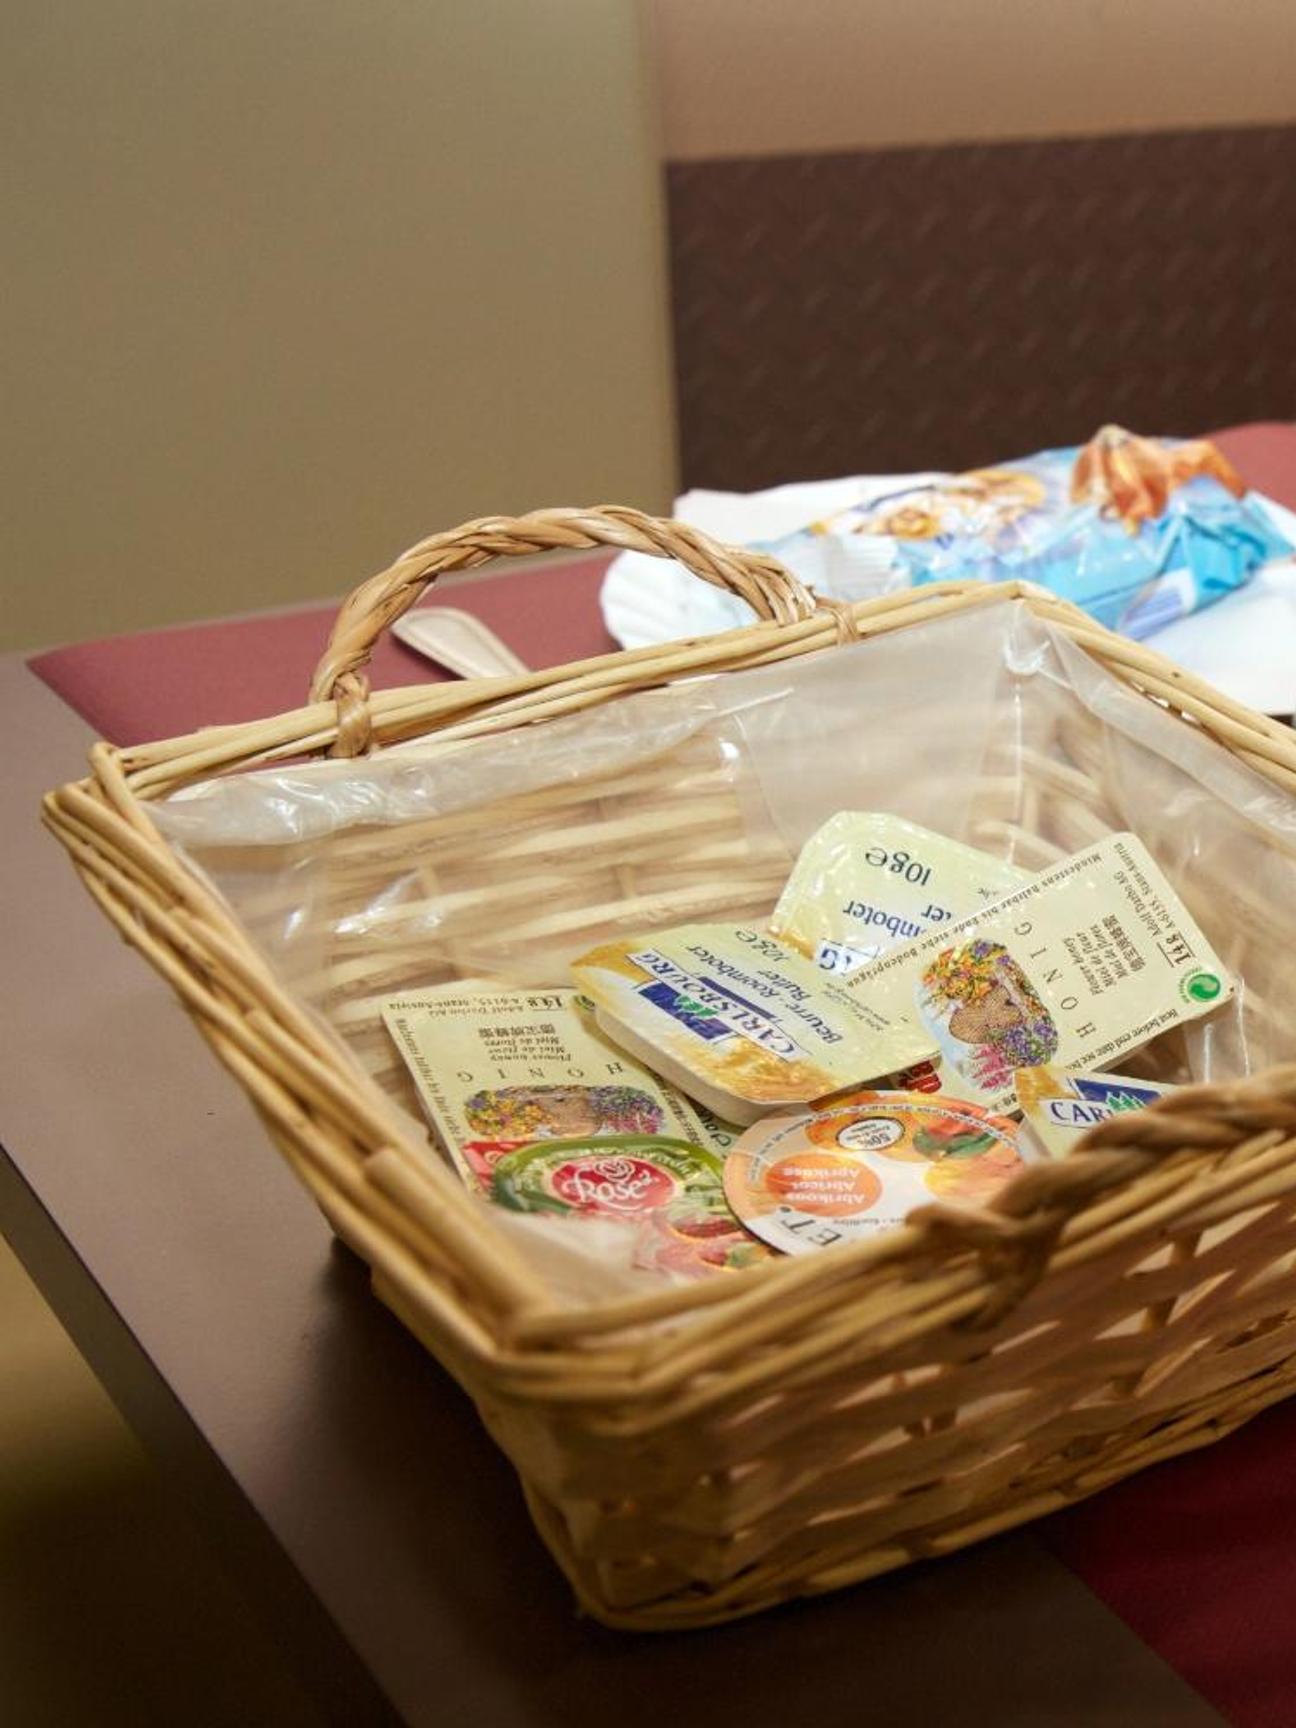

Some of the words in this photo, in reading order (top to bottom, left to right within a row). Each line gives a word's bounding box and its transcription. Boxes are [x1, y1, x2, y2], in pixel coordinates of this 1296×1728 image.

[1121, 882, 1146, 913] Darbo
[842, 900, 920, 939] mboter
[1138, 910, 1162, 939] Adolf
[1059, 933, 1087, 966] honey
[1088, 952, 1102, 967] de
[1102, 947, 1117, 962] de
[1166, 941, 1192, 967] 14
[684, 944, 778, 1000] Roomboter
[1012, 918, 1096, 1040] HONIG
[1095, 964, 1116, 989] Miel
[1108, 957, 1129, 981] Miel
[755, 968, 812, 1001] Butter
[635, 953, 793, 1051] CARLSBOURG
[1158, 1007, 1178, 1024] Best
[785, 1004, 842, 1044] Beurre
[1130, 1017, 1161, 1040] before
[1114, 1032, 1132, 1048] end
[456, 1061, 622, 1082] HONIG
